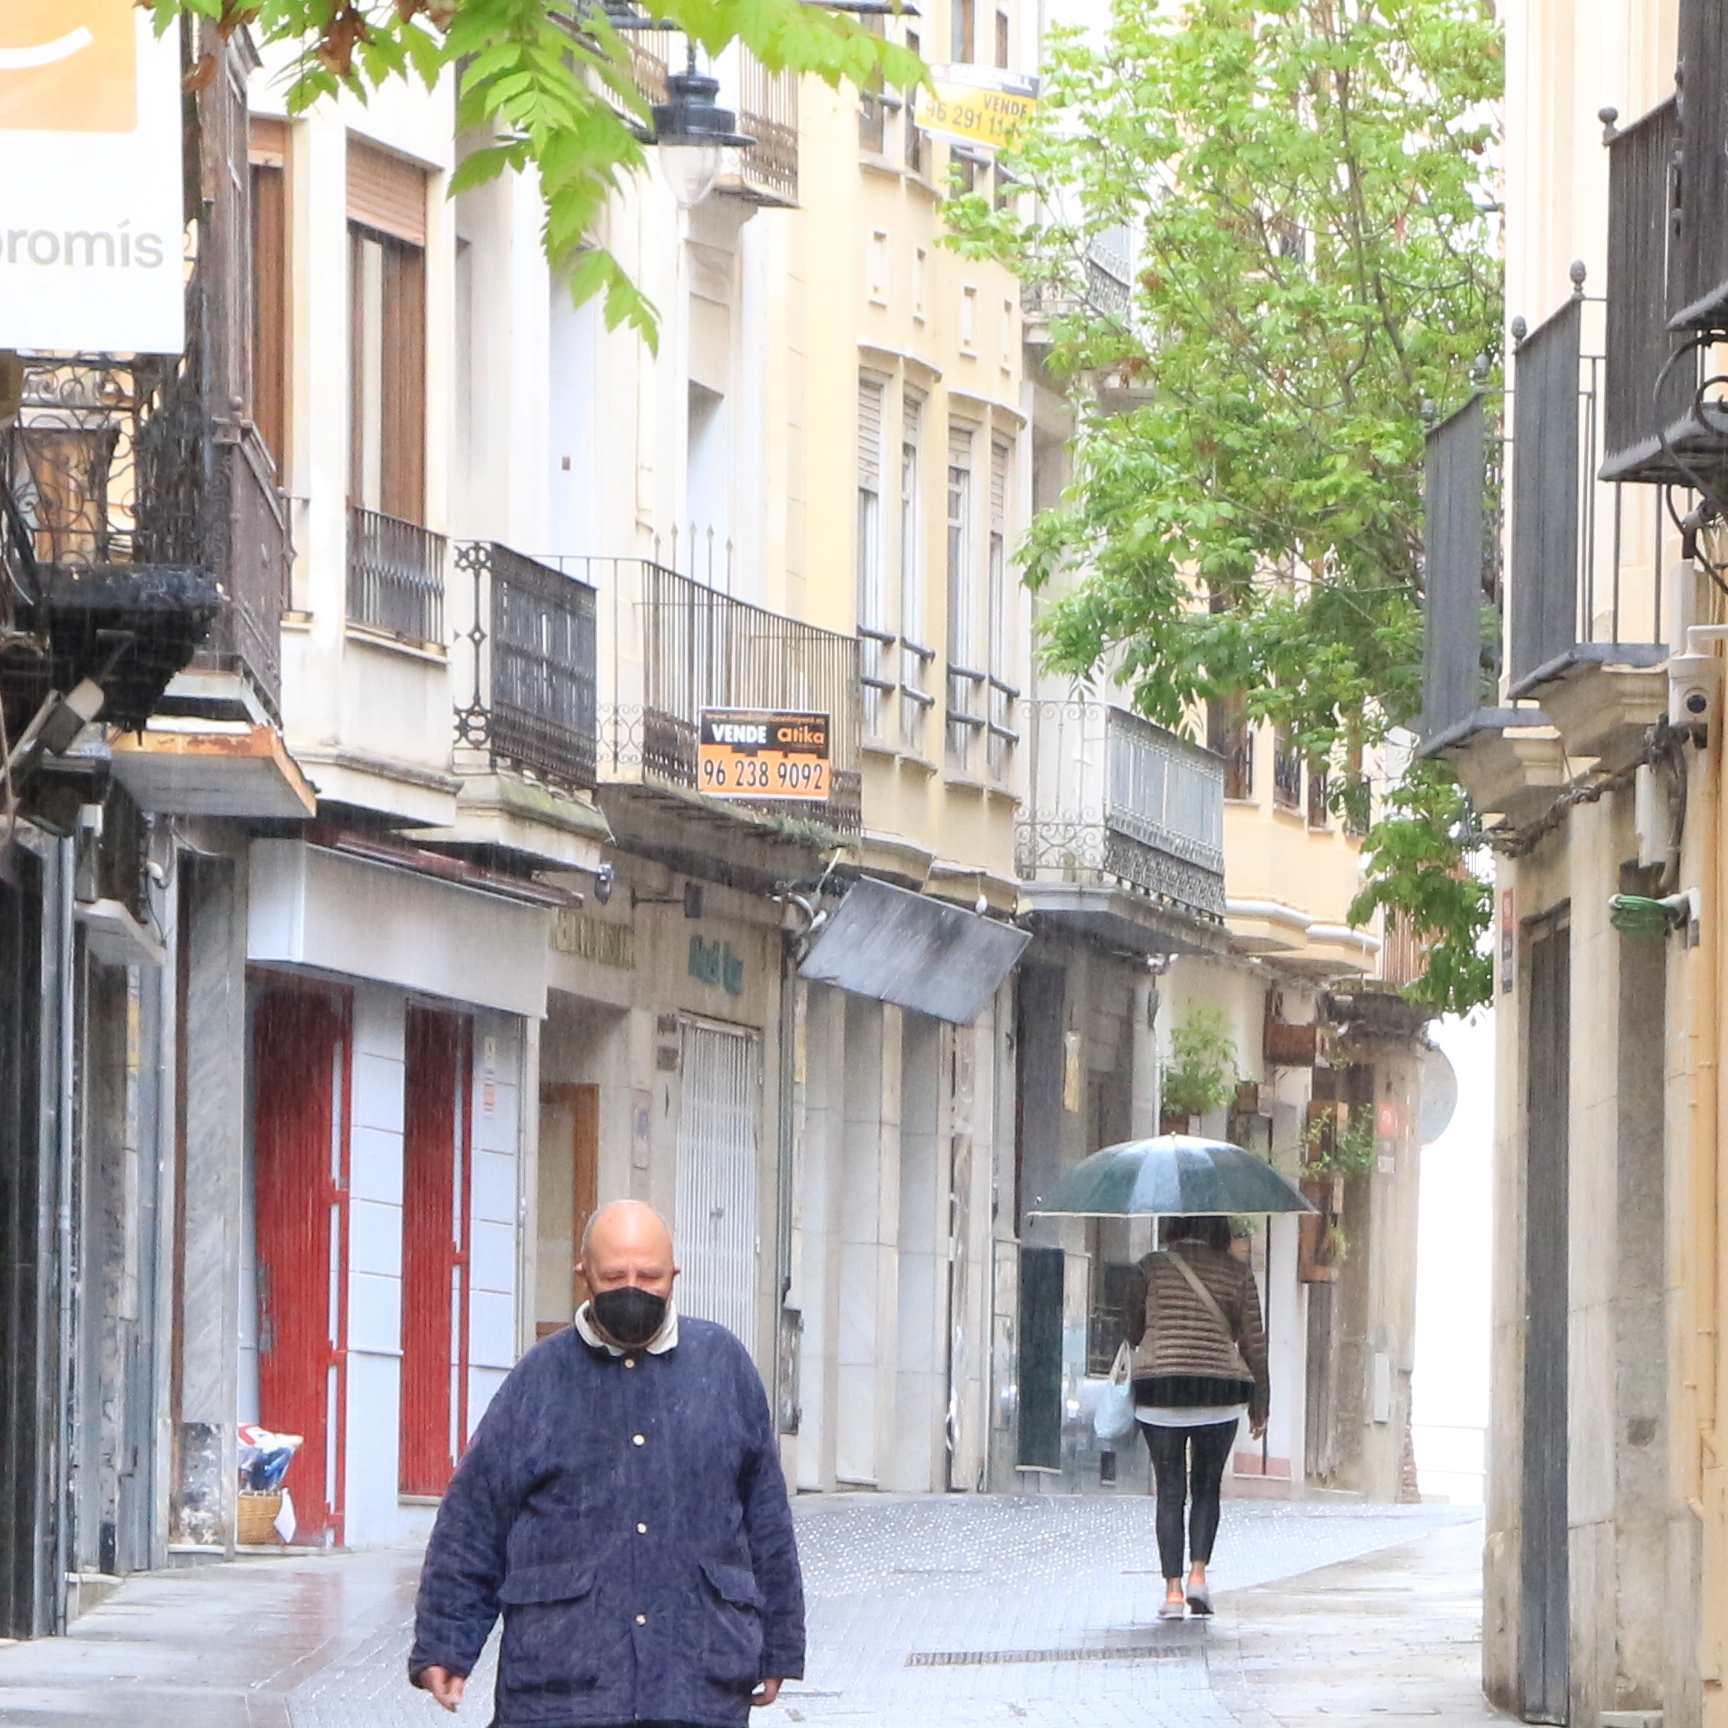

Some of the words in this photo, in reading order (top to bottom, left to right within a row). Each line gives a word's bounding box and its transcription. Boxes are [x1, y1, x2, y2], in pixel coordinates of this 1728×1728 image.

[925, 100, 947, 122] 96
[952, 105, 983, 131] 291
[983, 93, 1028, 119] VENDE
[0, 218, 164, 269] romís
[711, 723, 768, 744] VENDE
[776, 725, 825, 744] atika
[703, 759, 726, 787] 96
[734, 760, 769, 788] 238
[777, 761, 823, 790] 9092
